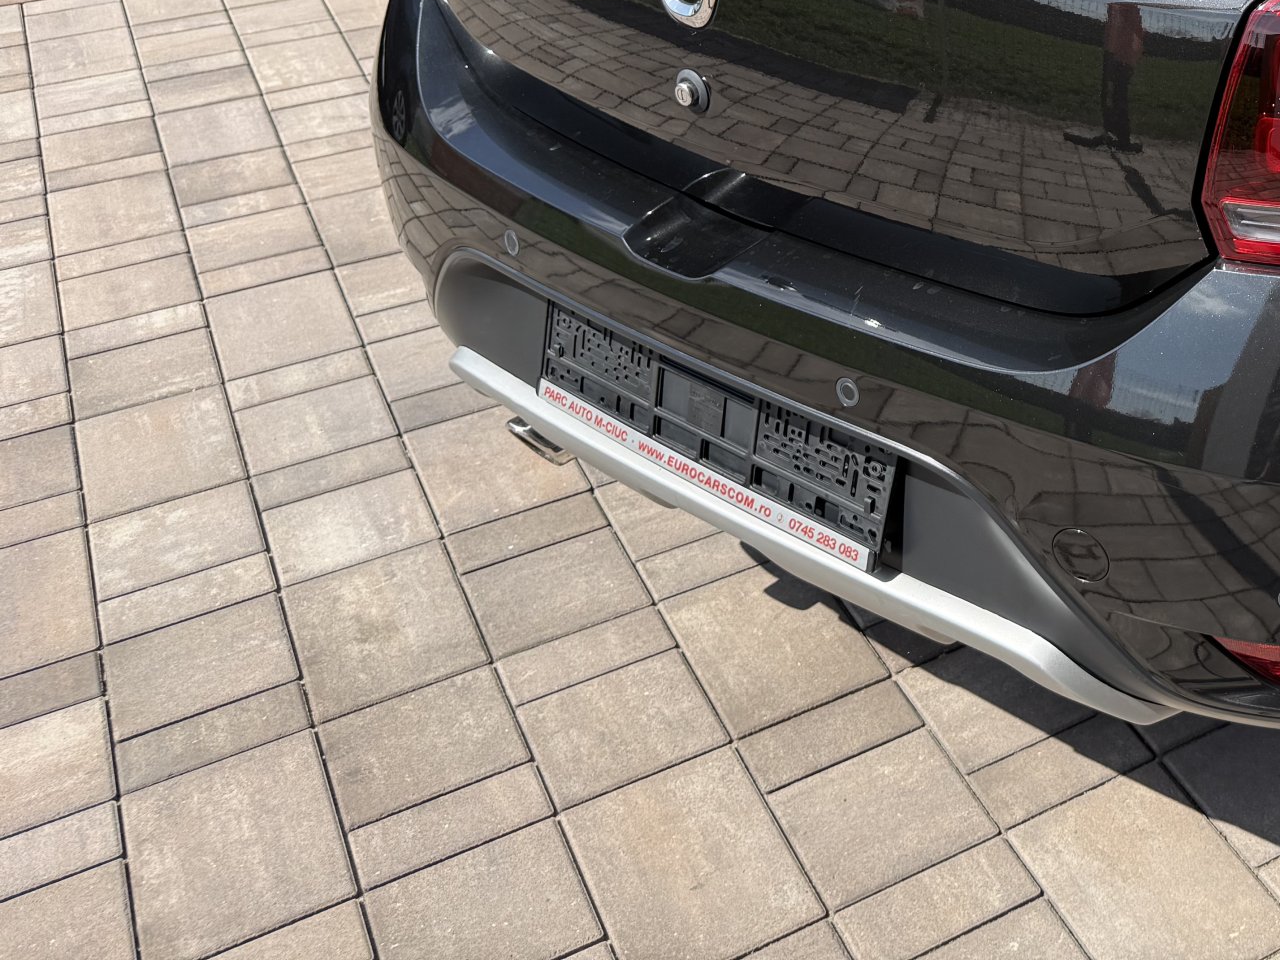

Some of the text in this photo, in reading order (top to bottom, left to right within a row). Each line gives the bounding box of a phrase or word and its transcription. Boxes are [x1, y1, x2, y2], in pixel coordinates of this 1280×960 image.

[544, 386, 568, 408] PARC
[568, 400, 593, 422] AUTO
[593, 415, 629, 442] M-CIUC
[788, 518, 816, 540] 0745
[815, 531, 838, 551] 283
[838, 542, 860, 562] 083
